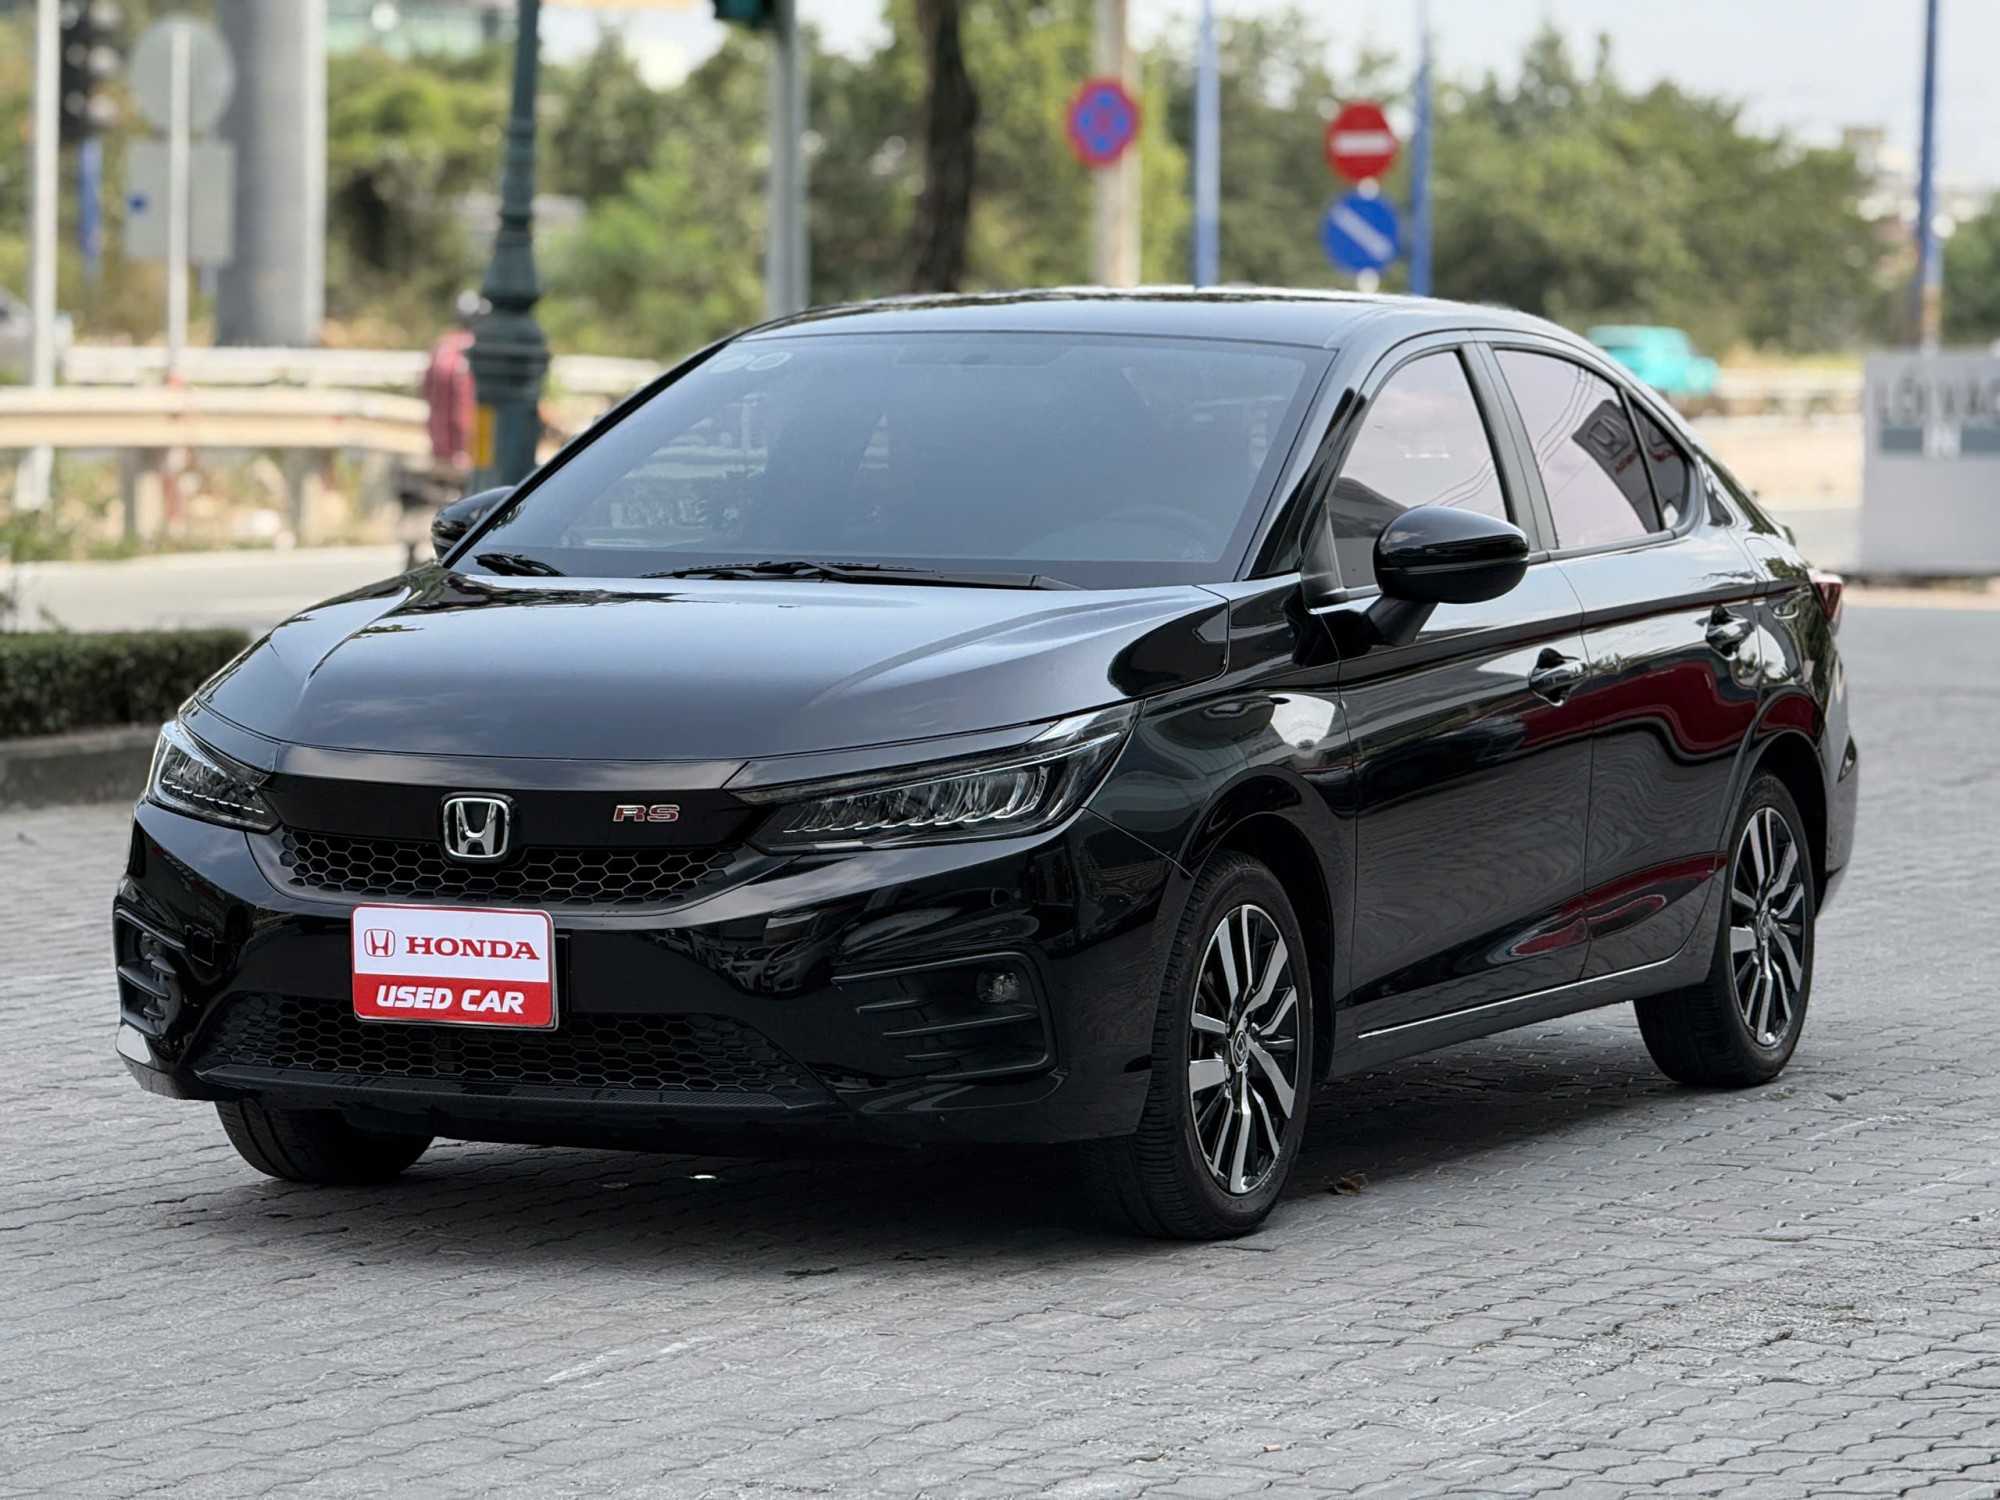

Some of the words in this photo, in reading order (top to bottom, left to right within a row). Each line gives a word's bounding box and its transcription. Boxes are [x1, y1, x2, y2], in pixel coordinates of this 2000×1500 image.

[612, 804, 681, 823] RS
[405, 936, 540, 960] HONDA
[376, 985, 453, 1010] USED
[461, 989, 525, 1014] CAR
